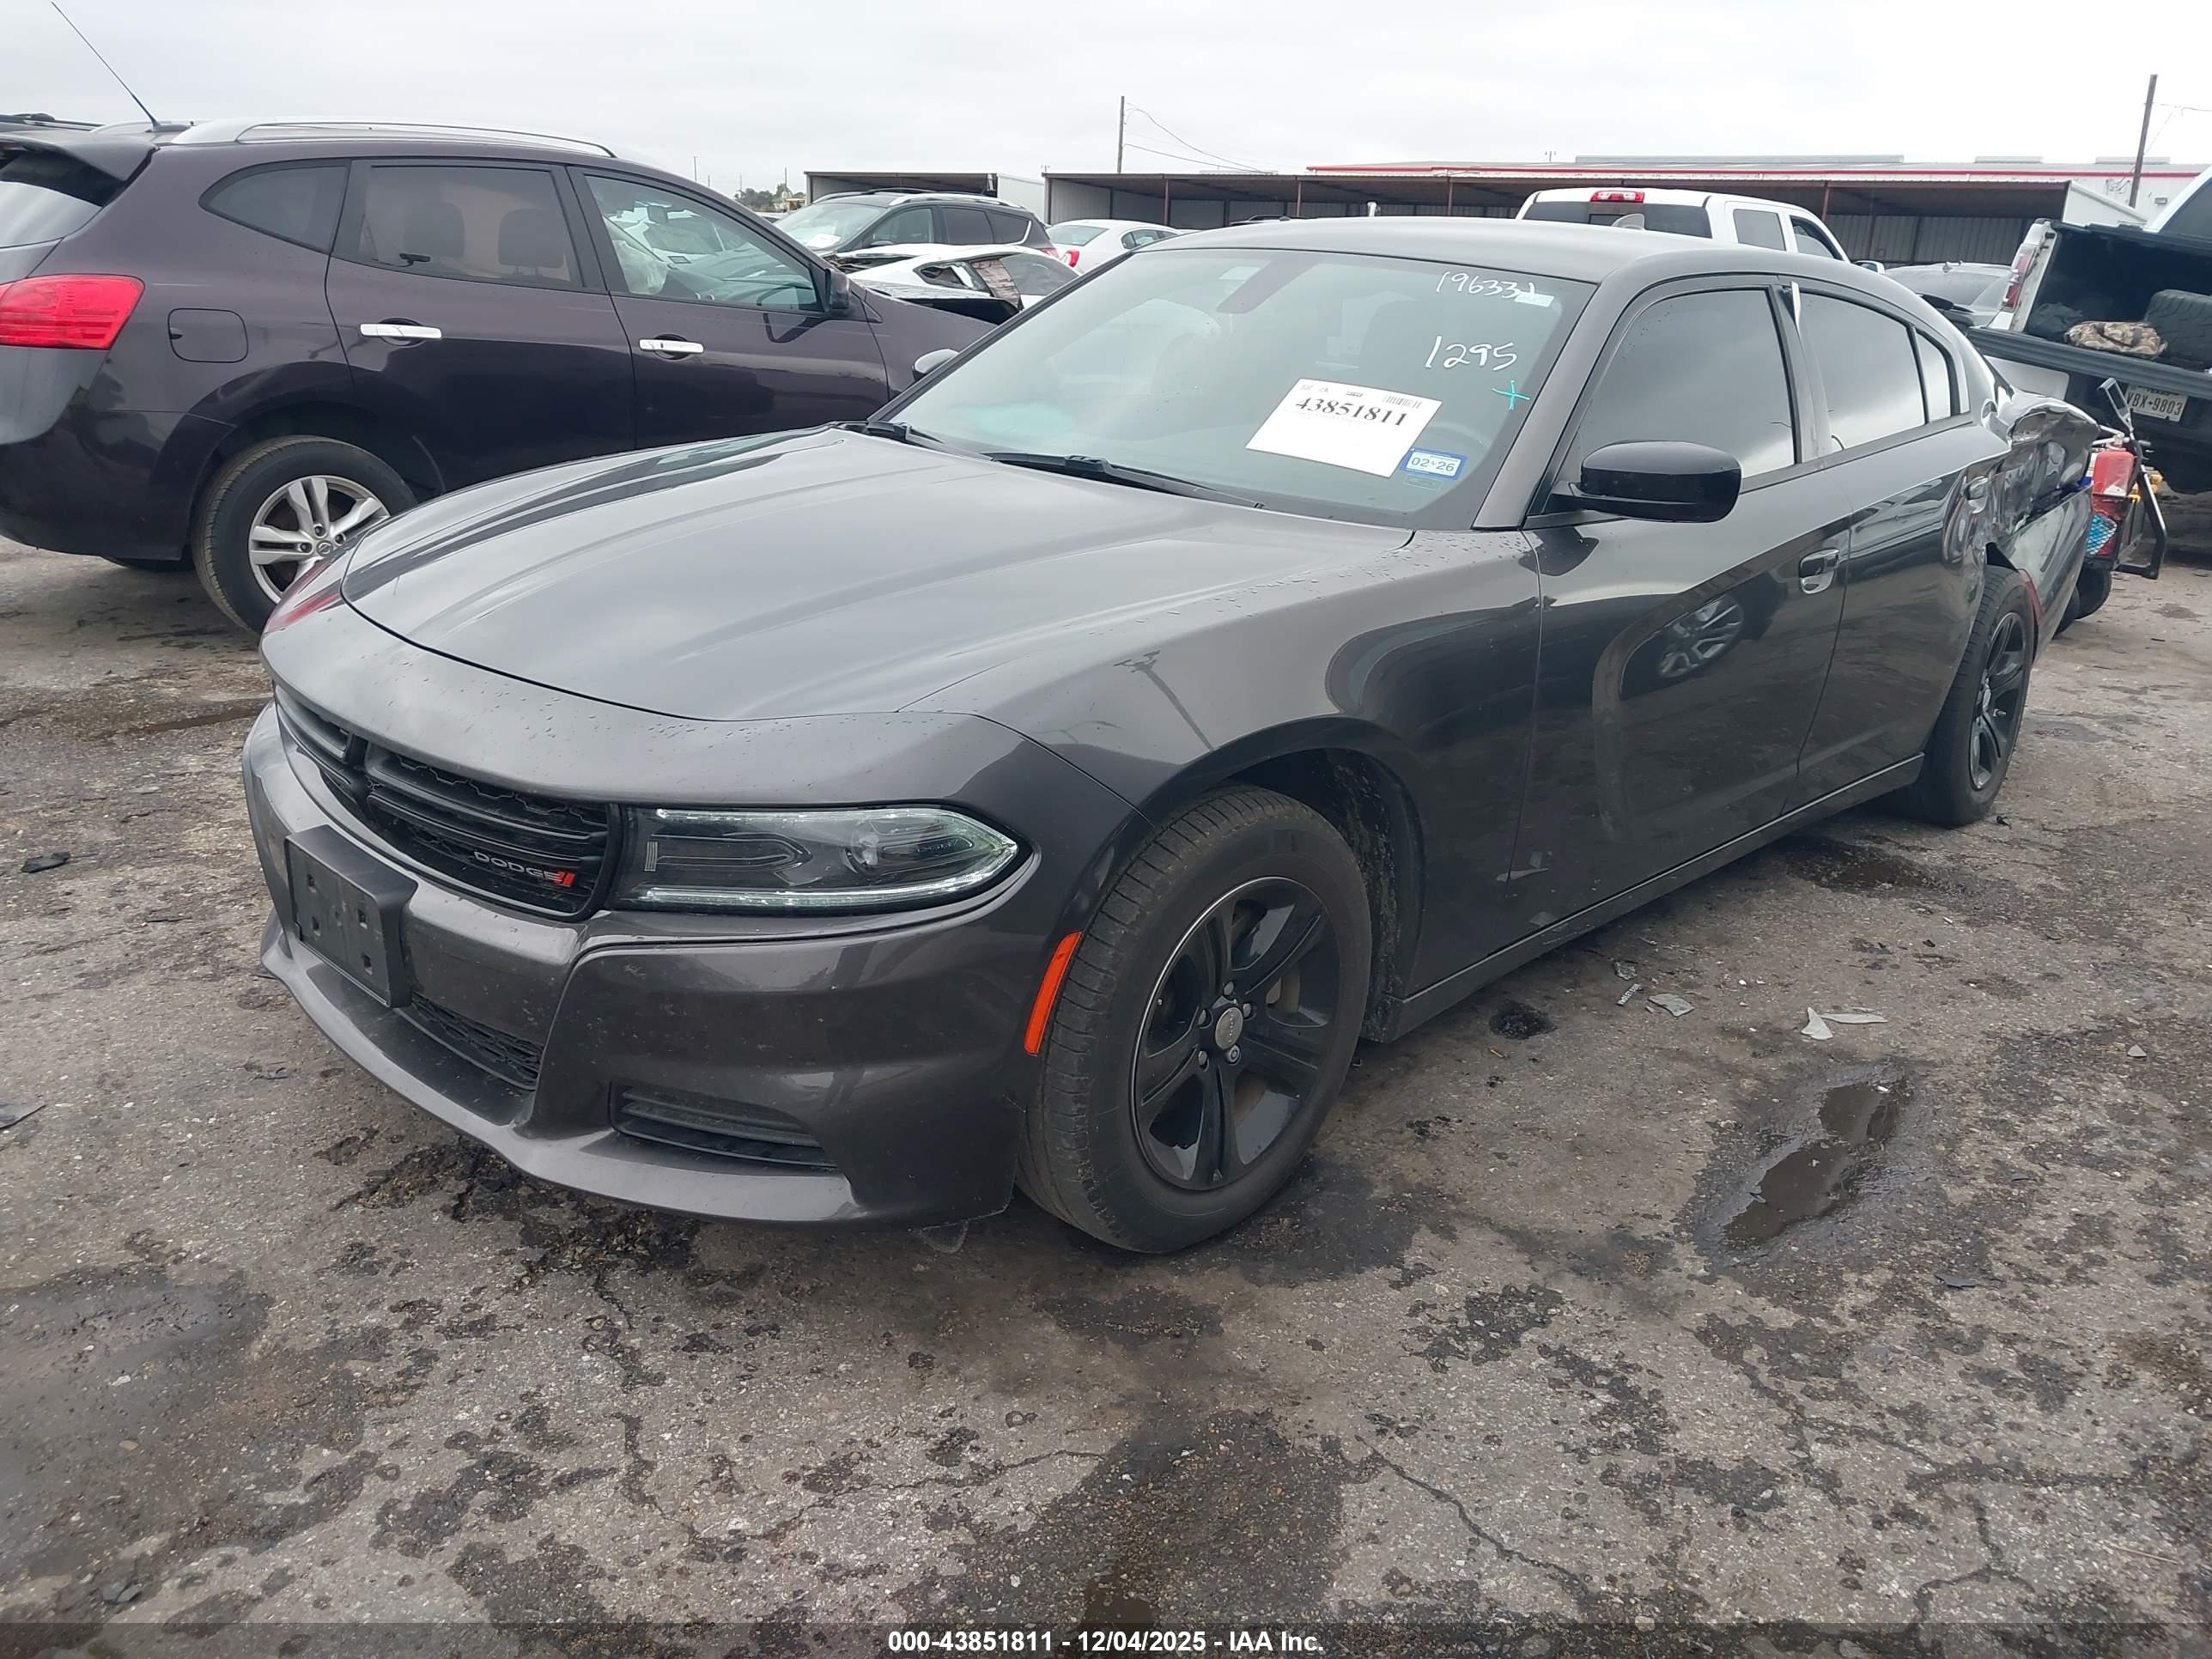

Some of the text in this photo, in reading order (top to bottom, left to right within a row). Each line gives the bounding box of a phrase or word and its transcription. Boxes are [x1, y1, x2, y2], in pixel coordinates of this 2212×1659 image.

[1425, 336, 1518, 371] 1295
[1295, 397, 1407, 426] 43851811
[474, 851, 564, 882] DODGE
